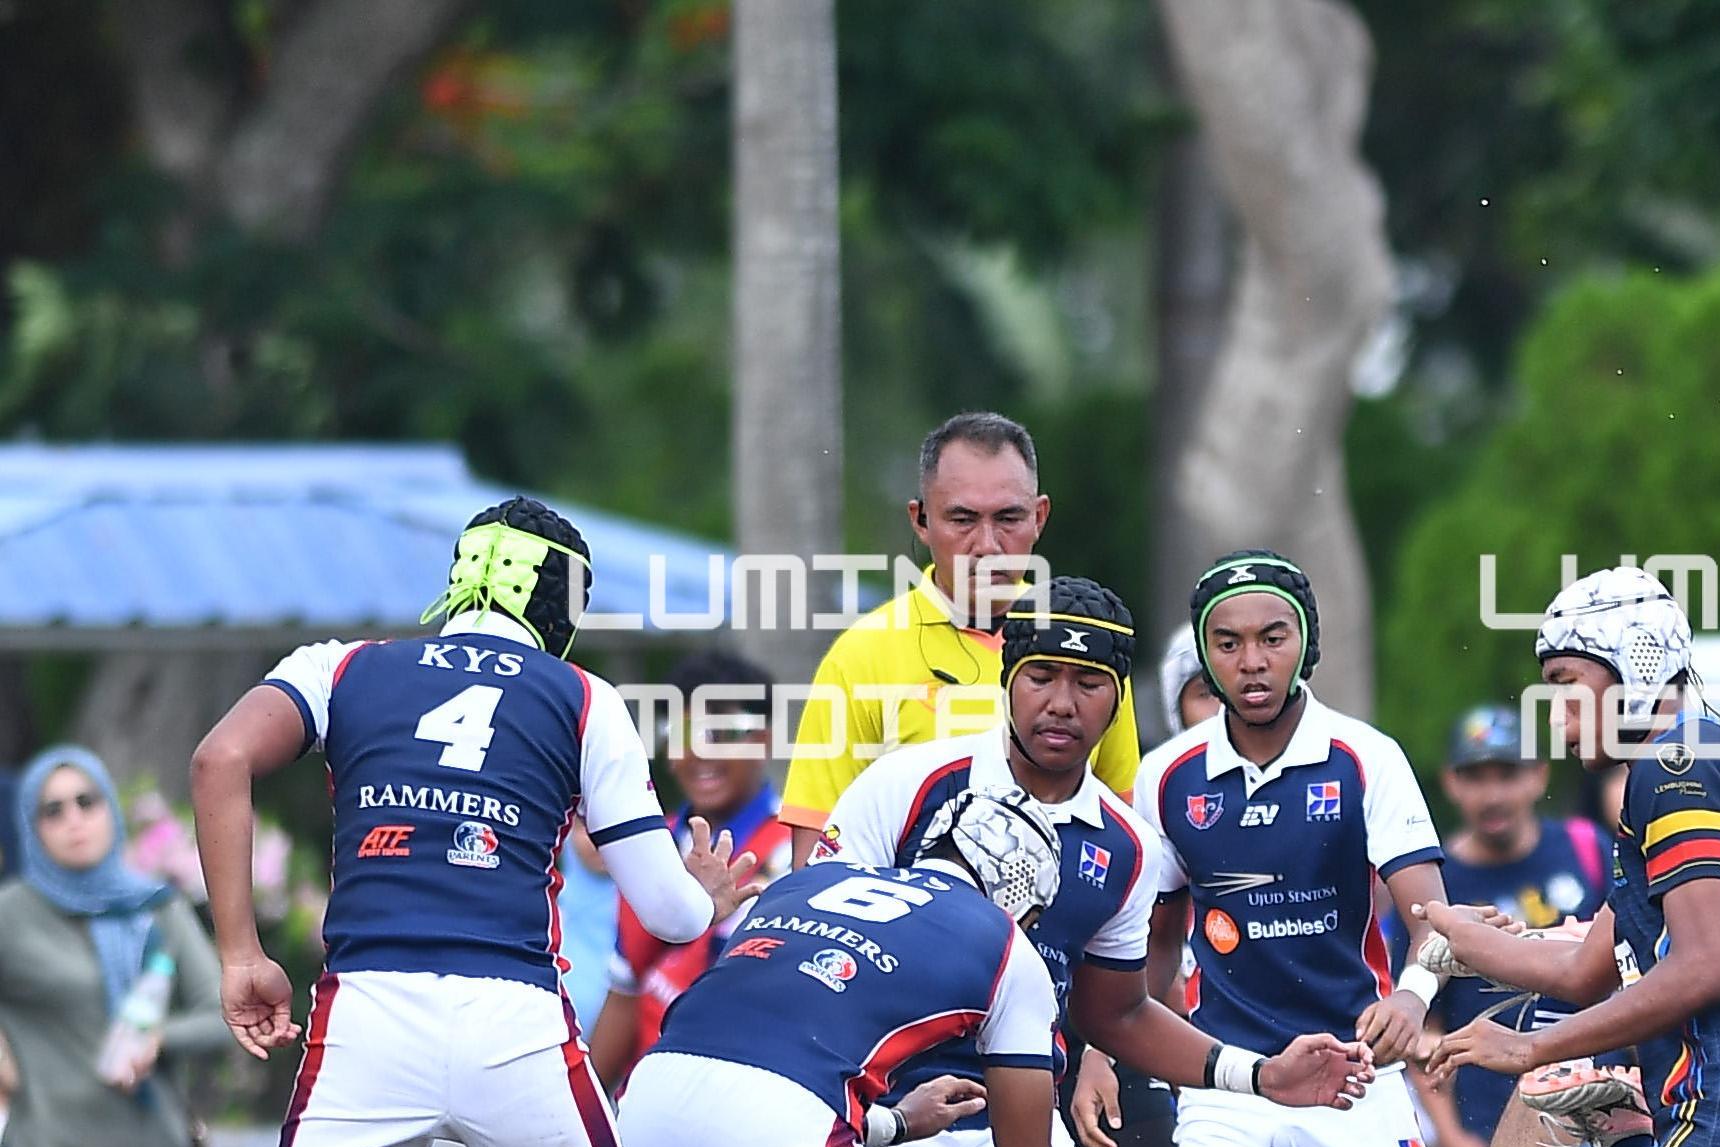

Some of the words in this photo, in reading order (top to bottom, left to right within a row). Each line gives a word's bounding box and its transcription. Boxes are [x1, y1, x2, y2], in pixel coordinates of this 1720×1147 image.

[417, 643, 525, 676] KYS
[413, 684, 504, 773] 4
[358, 784, 521, 827] RAMMERS
[807, 876, 934, 923] 6
[1248, 892, 1285, 907] UJUD
[1288, 886, 1338, 904] SENTOSA
[744, 915, 900, 974] RAMMERS
